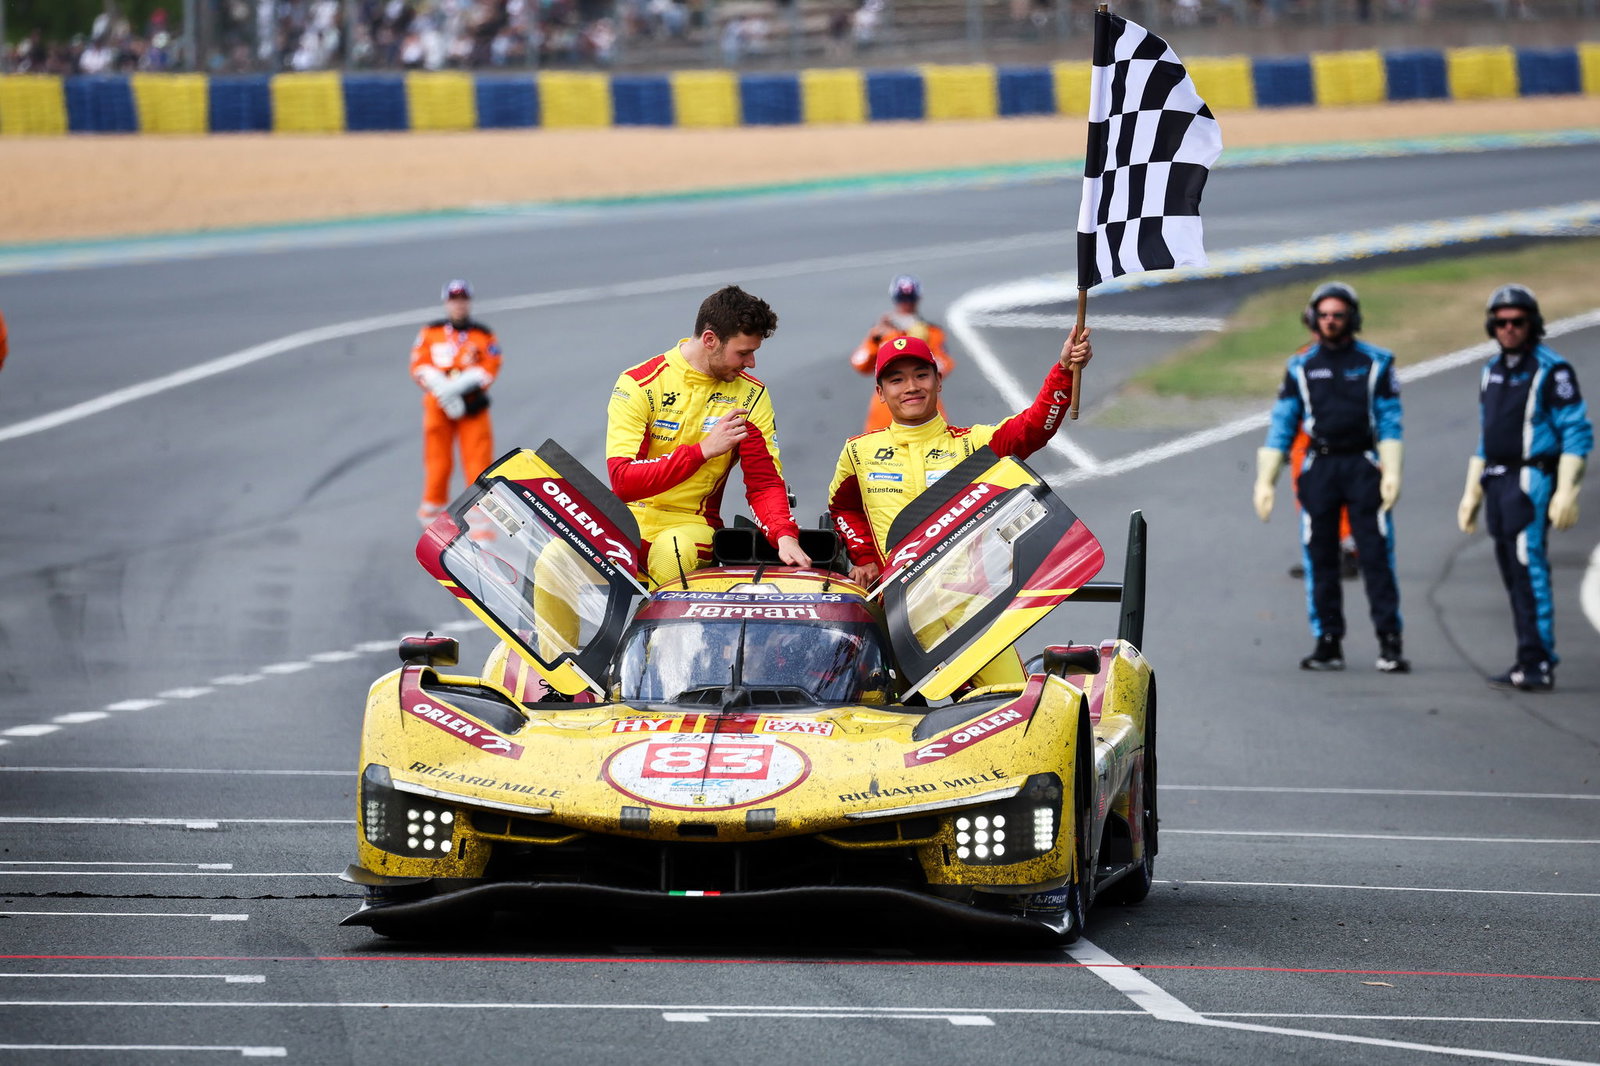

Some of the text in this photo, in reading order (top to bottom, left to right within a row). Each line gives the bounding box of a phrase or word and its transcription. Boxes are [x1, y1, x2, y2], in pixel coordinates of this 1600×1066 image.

[743, 387, 757, 409] Sabelt
[542, 481, 605, 538] ORLEN
[924, 480, 990, 540] ORLEN
[661, 592, 750, 601] CHARLES
[754, 594, 814, 602] POZZI
[679, 603, 821, 619] Ferrari
[412, 703, 480, 738] ORLEN
[615, 719, 671, 732] HY
[768, 725, 827, 734] CAR
[769, 720, 829, 728] HYPER
[952, 708, 1023, 745] ORLEN
[650, 746, 765, 774] 83
[408, 761, 565, 799] RICHARD MILLE
[838, 768, 1009, 803] RICHARD MILLE
